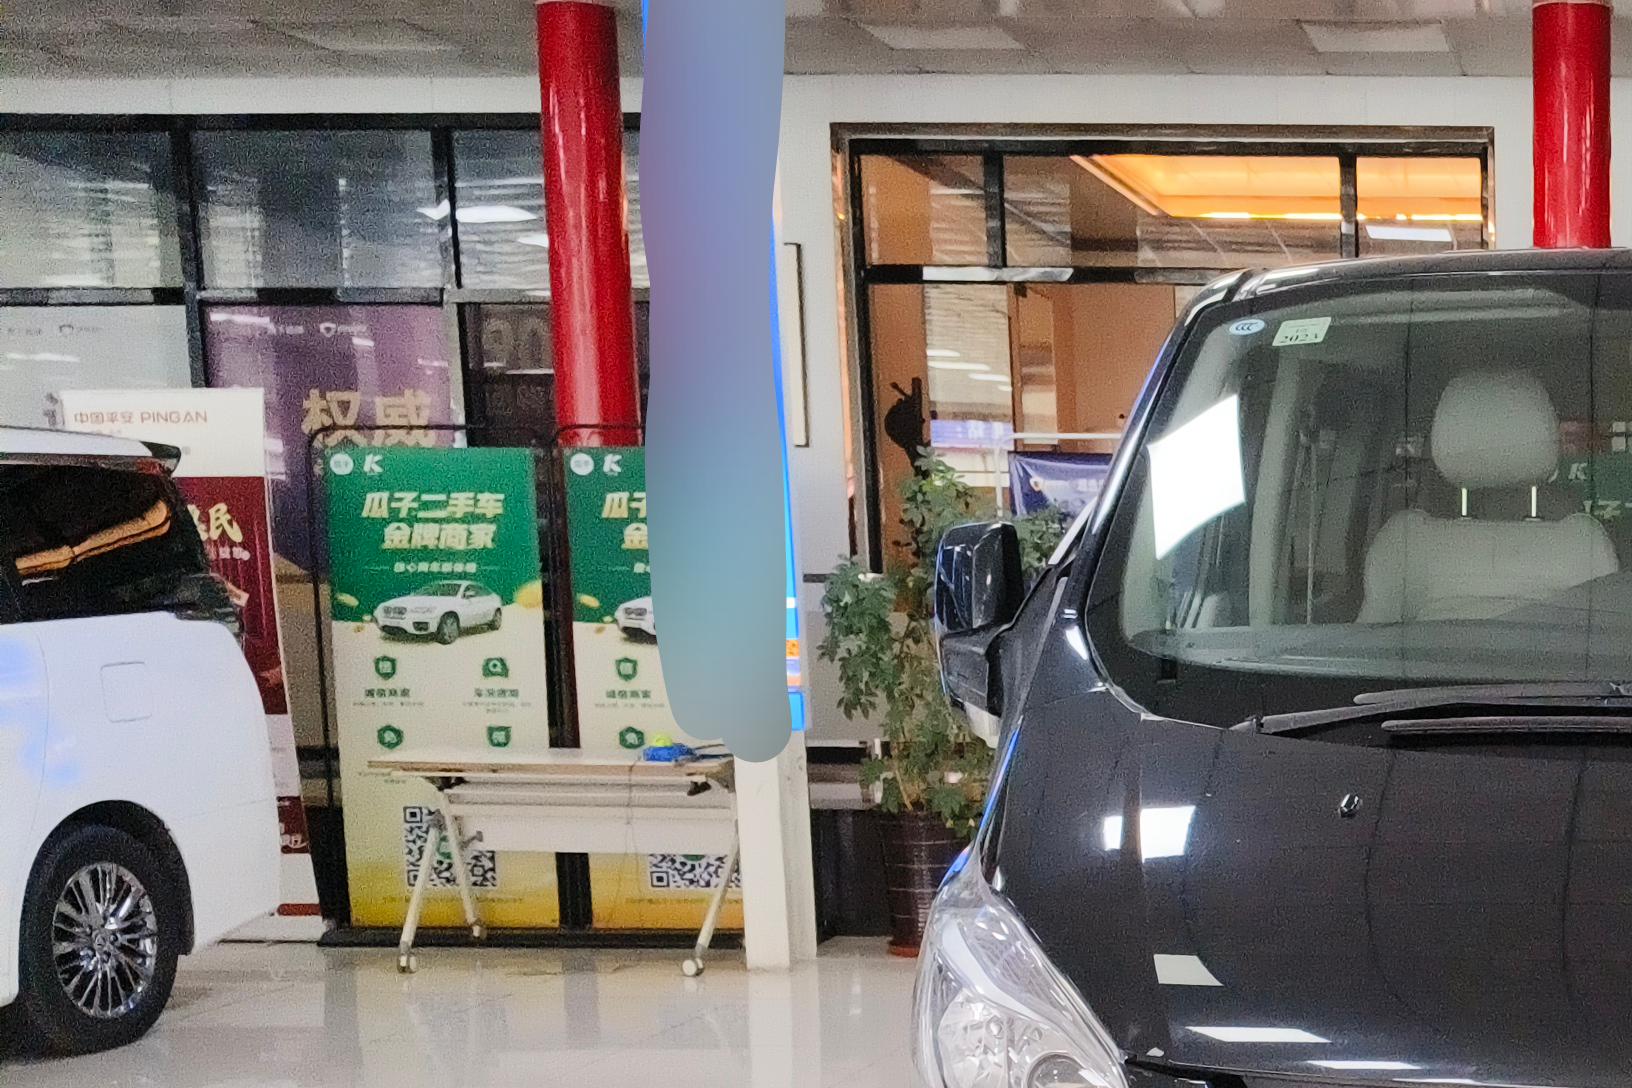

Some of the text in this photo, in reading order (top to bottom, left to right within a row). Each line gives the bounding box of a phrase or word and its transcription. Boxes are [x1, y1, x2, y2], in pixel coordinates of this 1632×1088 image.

[301, 388, 438, 449] 权威
[361, 491, 505, 519] 瓜子二手车
[382, 522, 497, 550] 金牌商家
